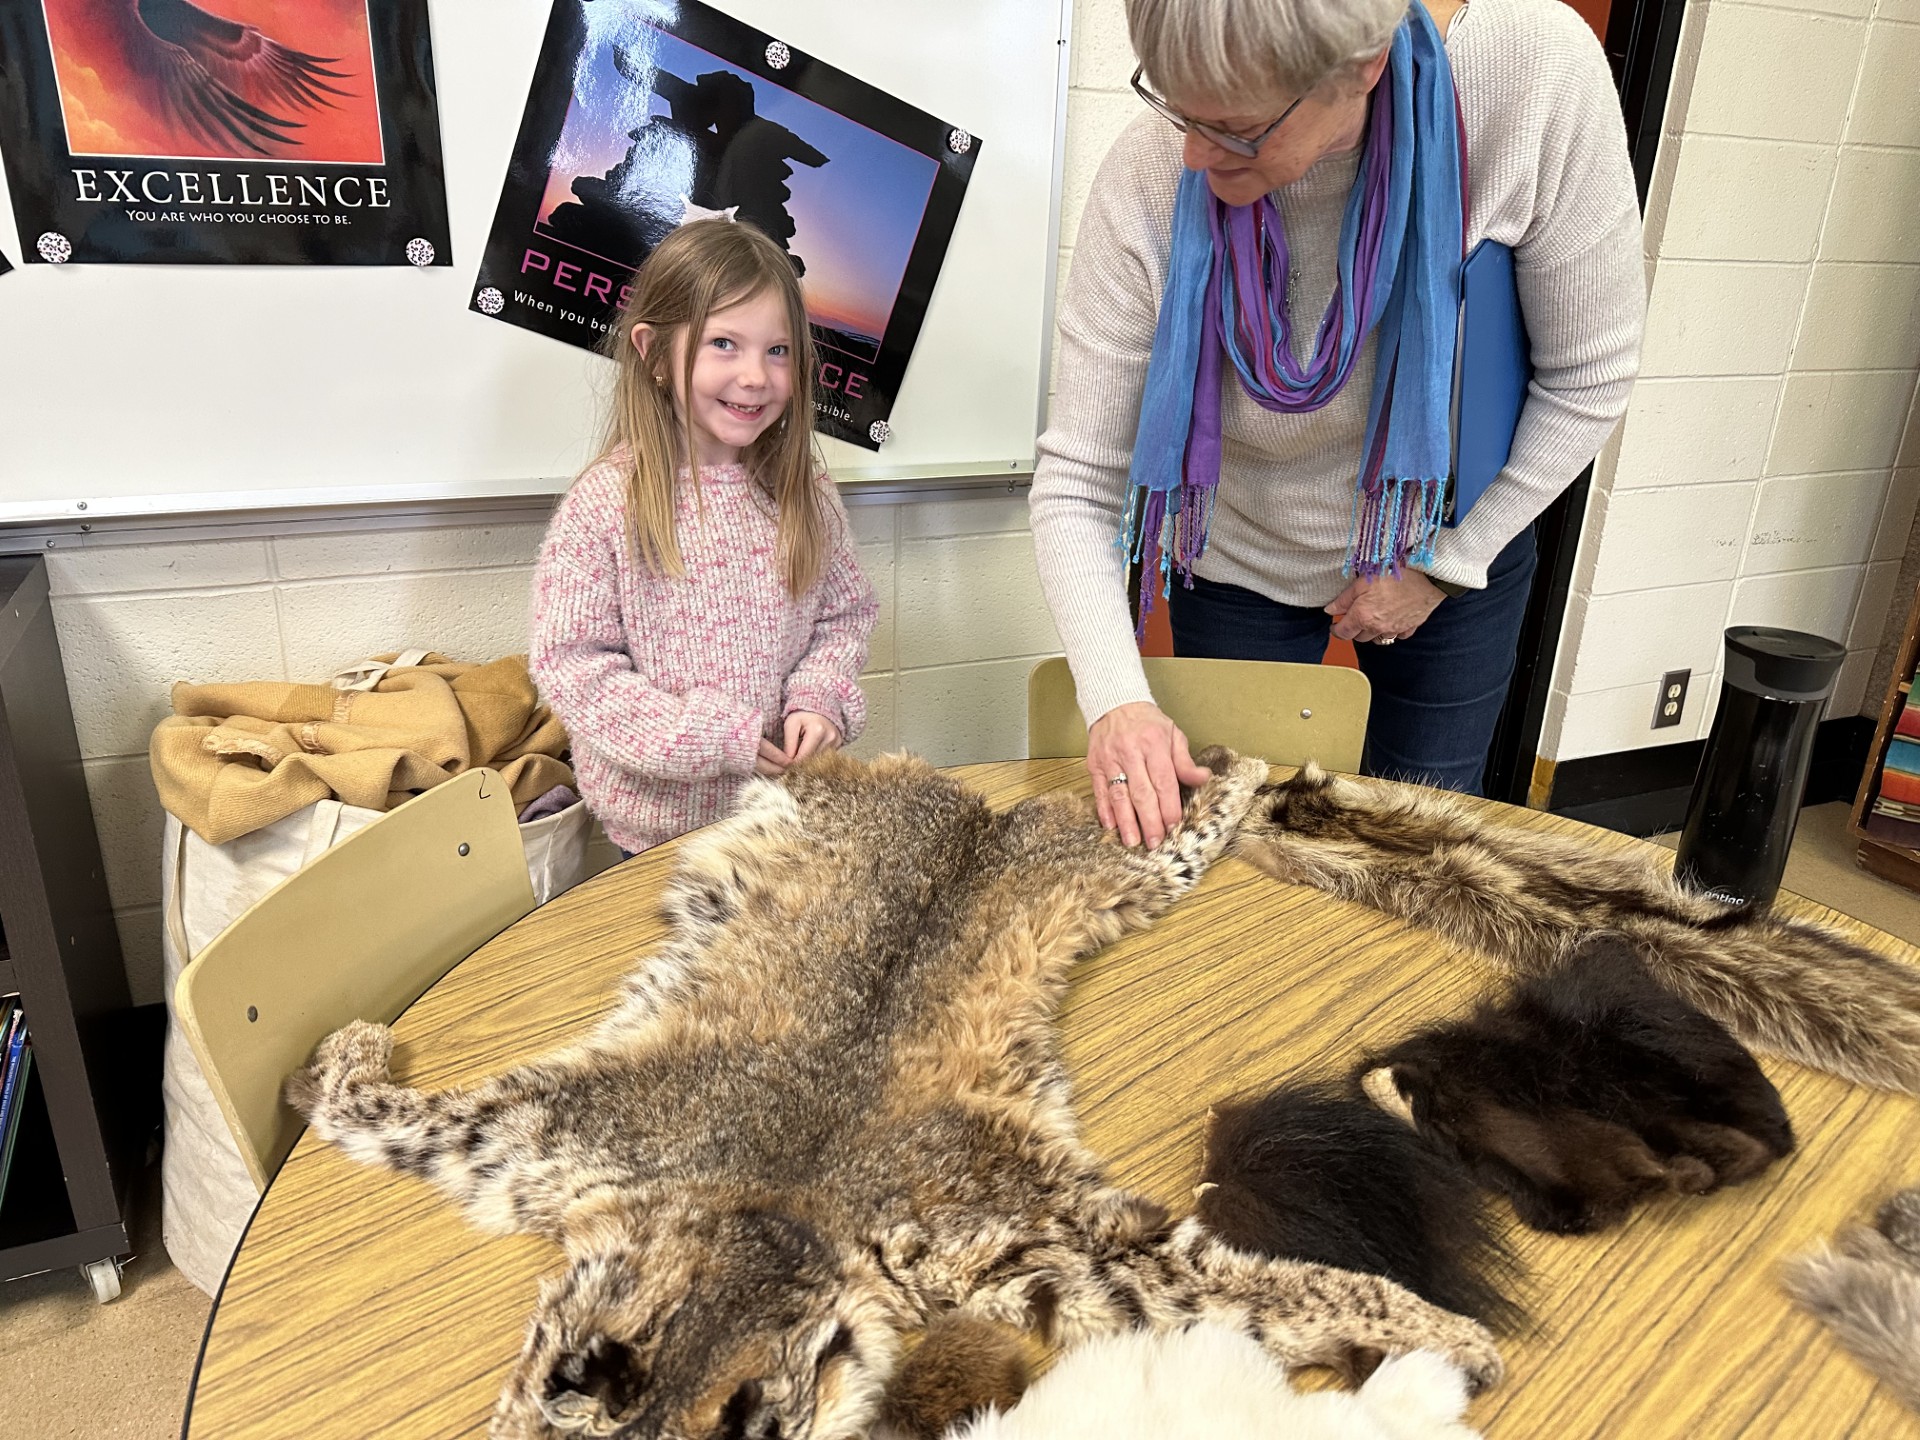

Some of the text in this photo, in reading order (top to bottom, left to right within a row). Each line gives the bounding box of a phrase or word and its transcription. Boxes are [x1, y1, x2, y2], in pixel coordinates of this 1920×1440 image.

[71, 168, 391, 208] EXCELLENCE
[125, 209, 352, 226] YOU ARE WHO YOU CHOOSE TO BE.
[513, 289, 554, 314] When
[559, 308, 586, 325] you
[810, 400, 854, 423] ossible.
